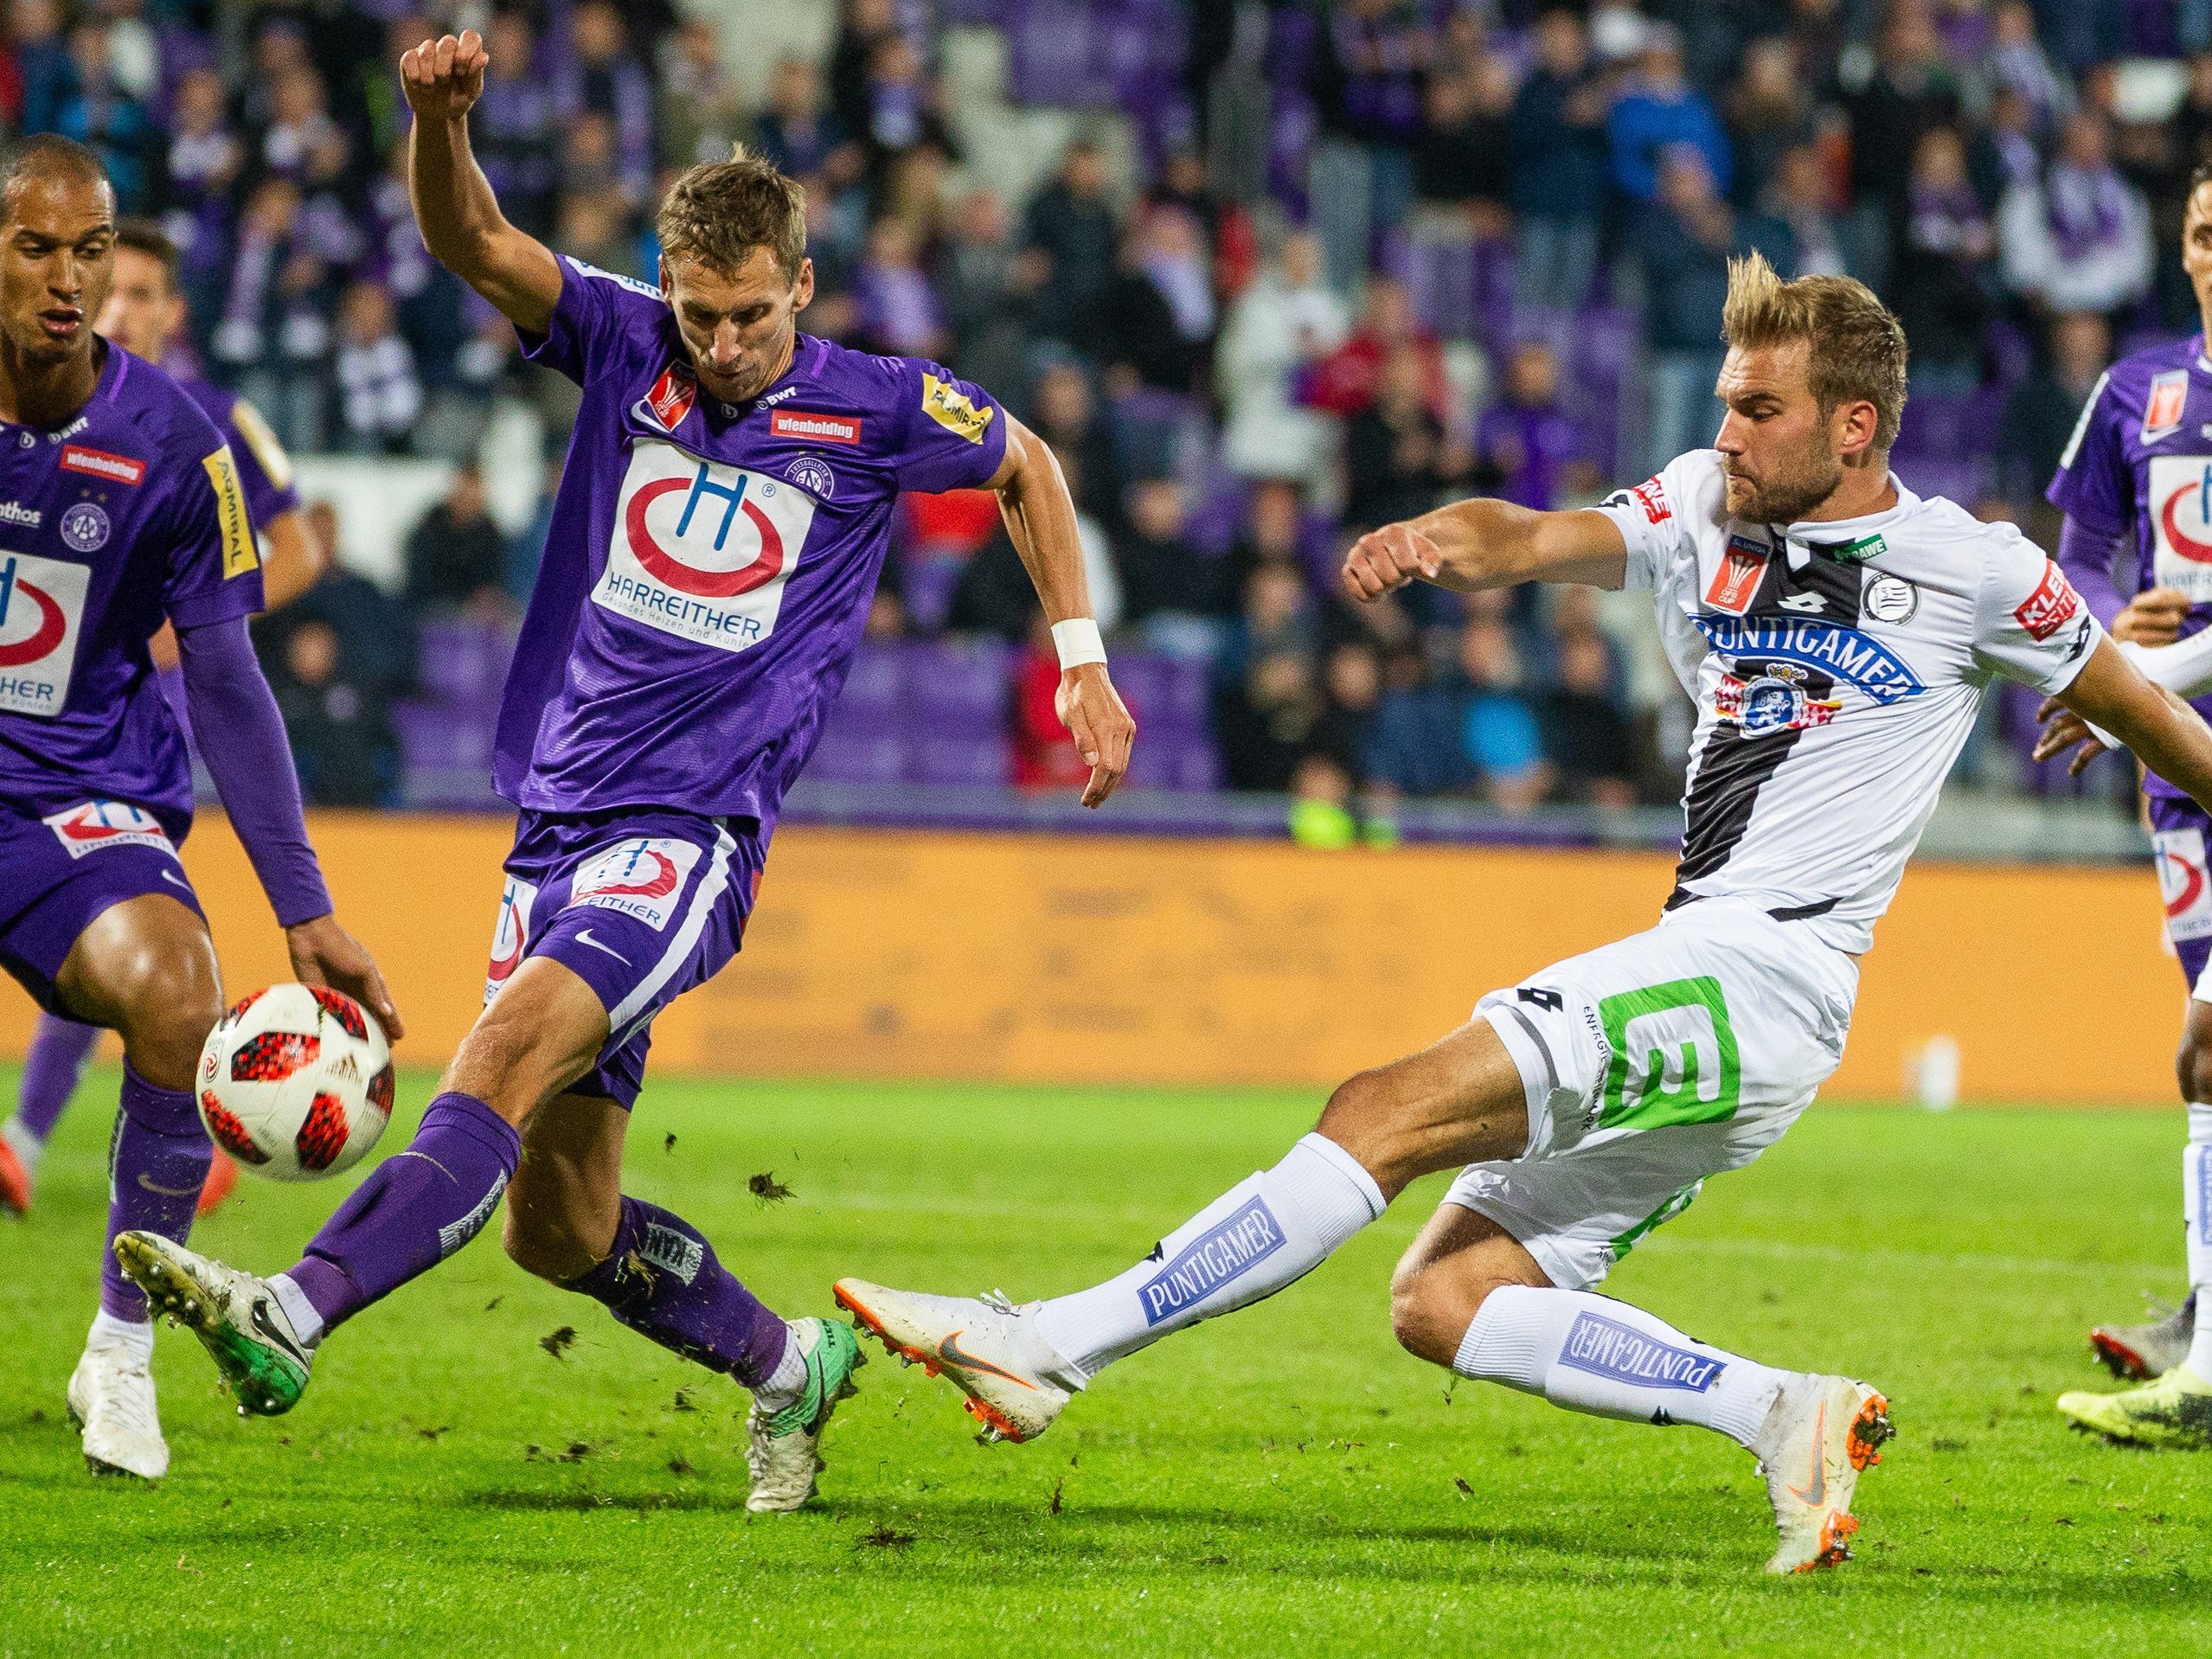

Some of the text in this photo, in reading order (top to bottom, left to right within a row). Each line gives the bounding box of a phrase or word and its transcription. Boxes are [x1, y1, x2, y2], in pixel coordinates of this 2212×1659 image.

[766, 387, 797, 406] BWT
[778, 419, 854, 439] wienholding
[216, 459, 243, 567] ADMIRAL
[601, 592, 644, 617] Gesundes
[648, 611, 683, 631] Heizen
[689, 628, 710, 639] und
[607, 571, 761, 640] HARREITHER
[1147, 1208, 1277, 1318] PUNTIGAMER
[1569, 1319, 1715, 1387] PUNTIGAMER
